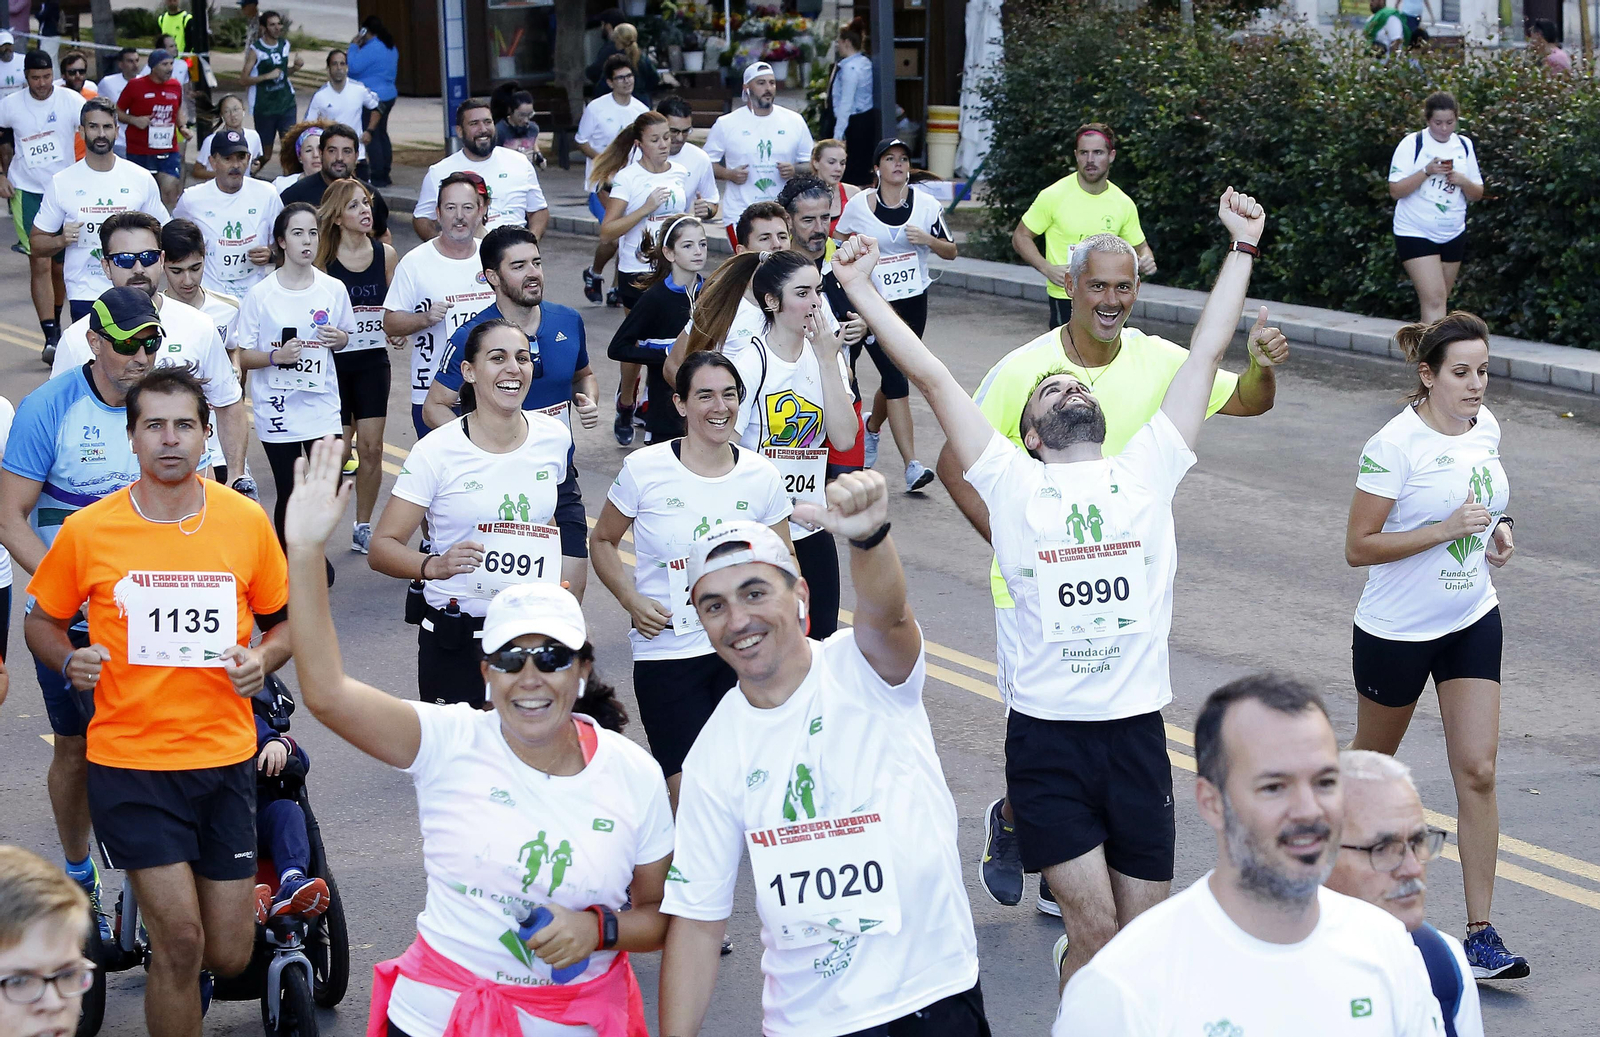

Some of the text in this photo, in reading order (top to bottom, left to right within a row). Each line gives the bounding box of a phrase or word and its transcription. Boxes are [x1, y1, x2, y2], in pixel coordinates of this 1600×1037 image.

[30, 142, 55, 156] 2683
[224, 253, 247, 266] 974
[878, 268, 916, 286] 8297
[350, 284, 379, 297] OST
[348, 320, 383, 334] 353
[278, 358, 321, 374] 621
[82, 426, 100, 440] 24
[764, 448, 776, 458] 41
[478, 522, 558, 536] 41 CARRERA URBANA
[1038, 540, 1142, 564] 41 CARRERA URBANA
[1060, 554, 1086, 562] CIUDAD
[484, 550, 546, 578] 6991
[670, 558, 685, 570] 41
[132, 574, 234, 587] 41 CARRERA URBANA
[1058, 576, 1130, 608] 6990
[148, 608, 220, 634] 1135
[1062, 646, 1120, 657] Fundación
[1071, 661, 1110, 674] Unicaja
[750, 813, 882, 848] 41 CARRERA URBANA
[780, 834, 812, 844] CIUDAD
[814, 832, 826, 840] DE
[769, 860, 884, 907] 17020
[470, 888, 483, 898] 41
